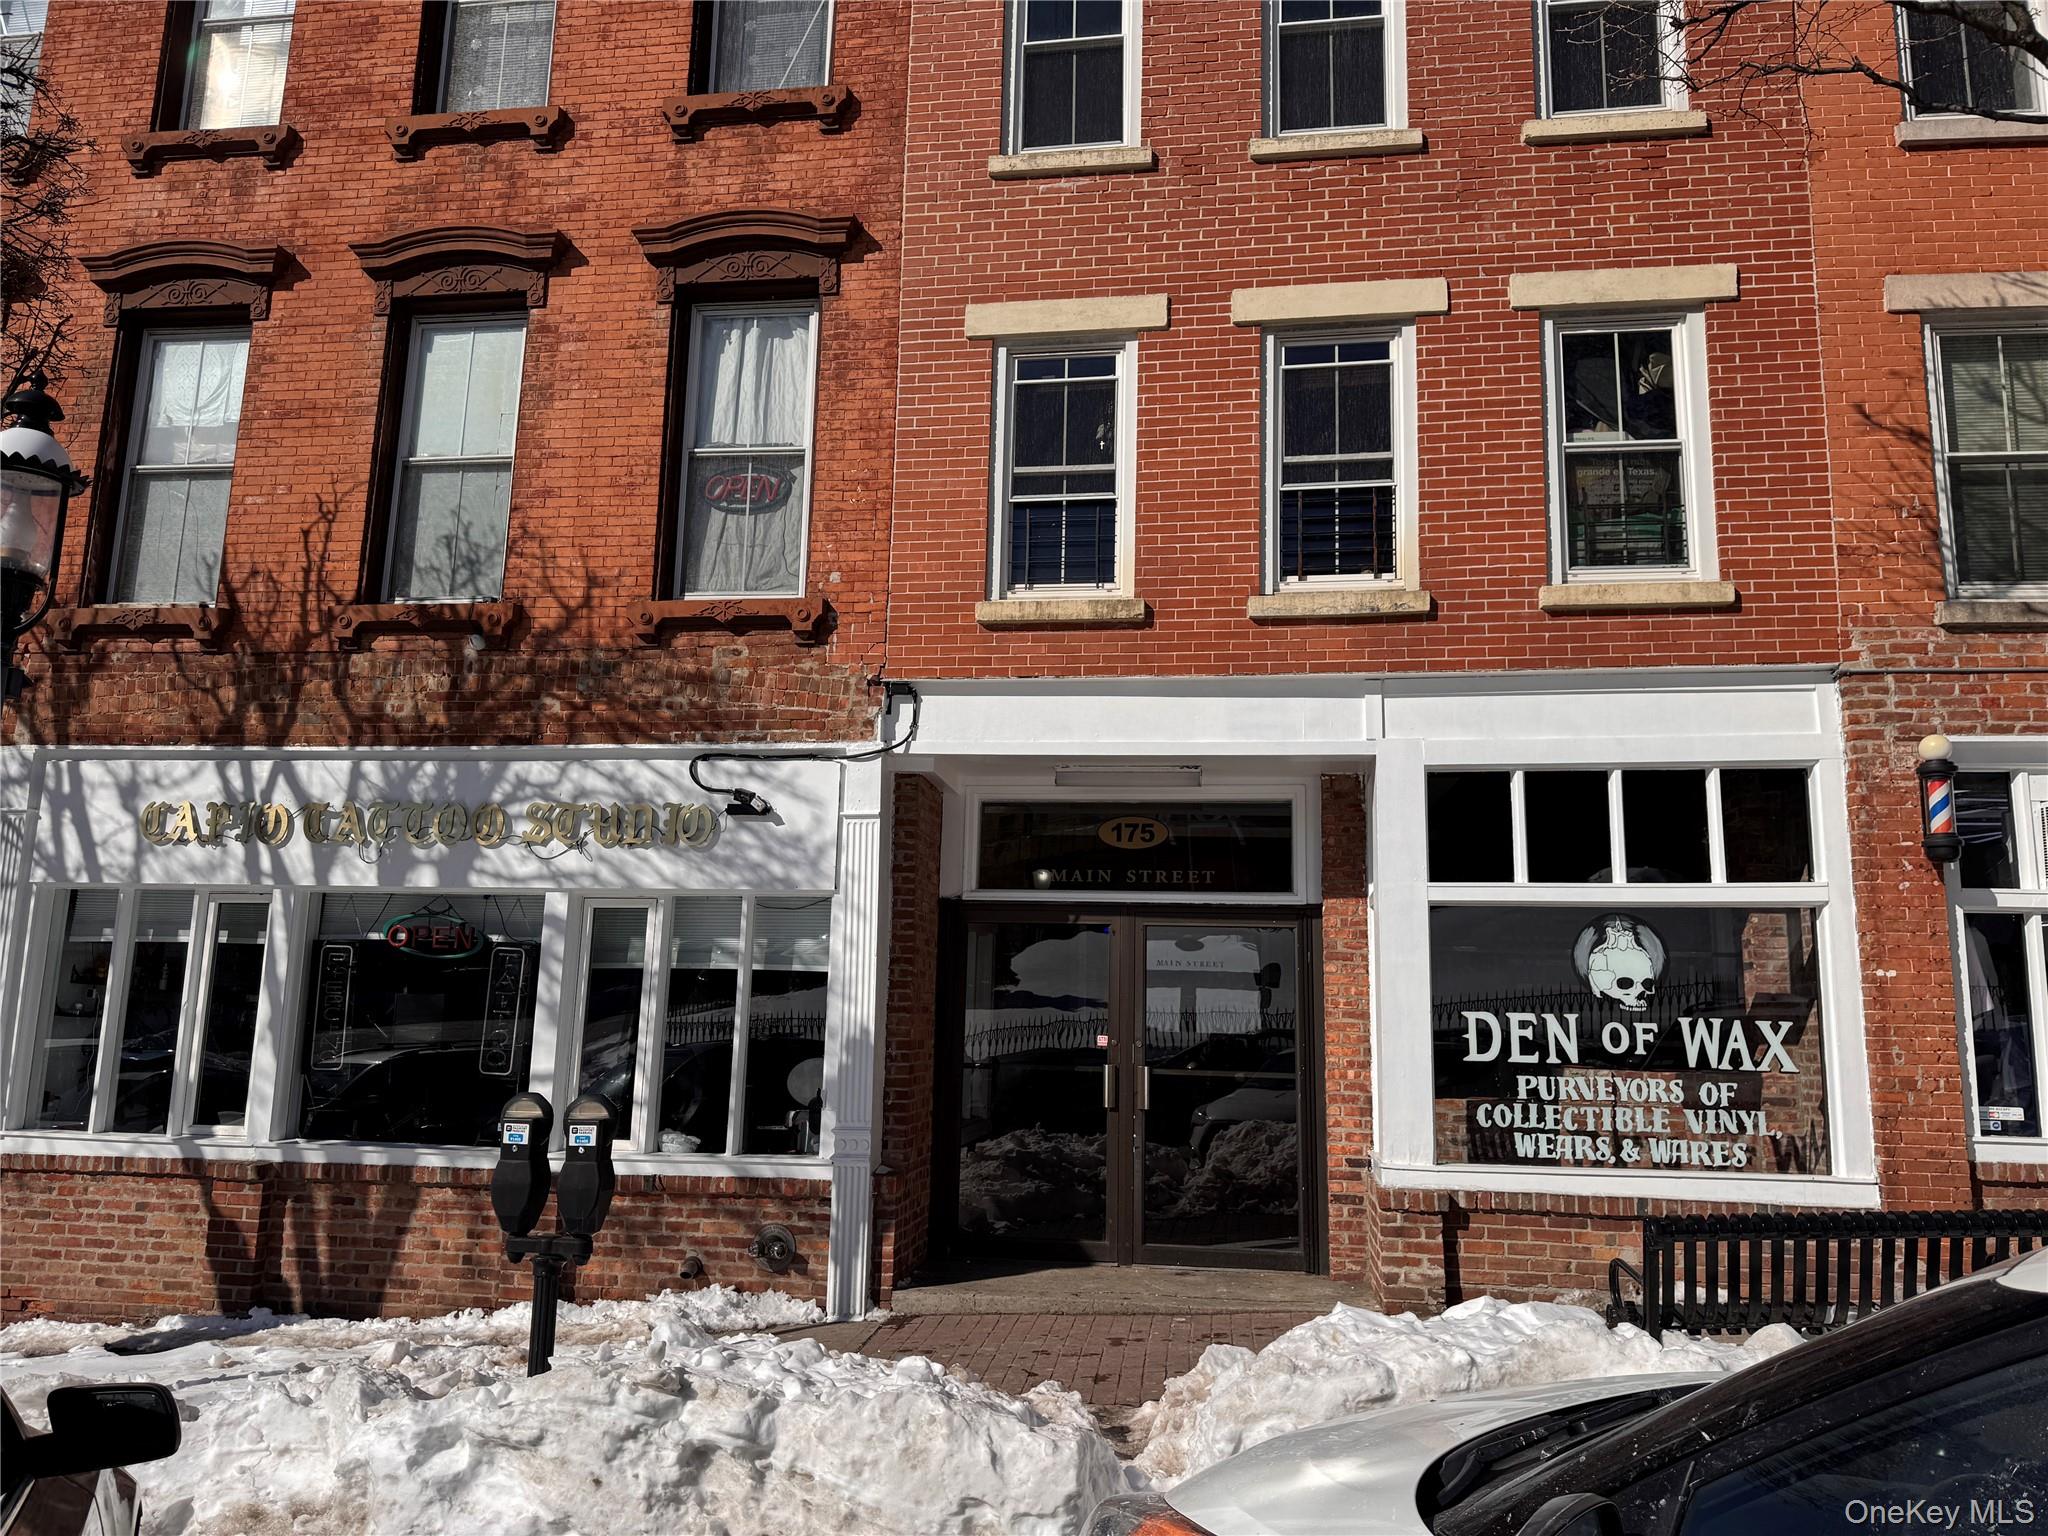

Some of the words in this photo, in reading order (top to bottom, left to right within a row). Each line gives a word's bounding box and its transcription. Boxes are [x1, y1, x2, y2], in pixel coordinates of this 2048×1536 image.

[705, 474, 783, 502] OPEN
[141, 800, 291, 847] CAPIO
[302, 800, 508, 848] TATTOO
[522, 801, 717, 847] STUDIO
[1110, 823, 1156, 844] 175
[1051, 869, 1112, 884] MAIN
[1126, 870, 1216, 884] STREET
[387, 924, 476, 950] OPEN
[1461, 1011, 1580, 1065] DEN
[1601, 1021, 1659, 1056] OF
[1677, 1016, 1800, 1073] WAX
[1515, 1075, 1685, 1104] PURVEYORS
[1698, 1081, 1738, 1108] OF
[1475, 1102, 1672, 1134] COLLECTIBLE
[1682, 1108, 1783, 1141] VINYL,
[1620, 1138, 1641, 1163] &
[1649, 1137, 1748, 1169] WARES
